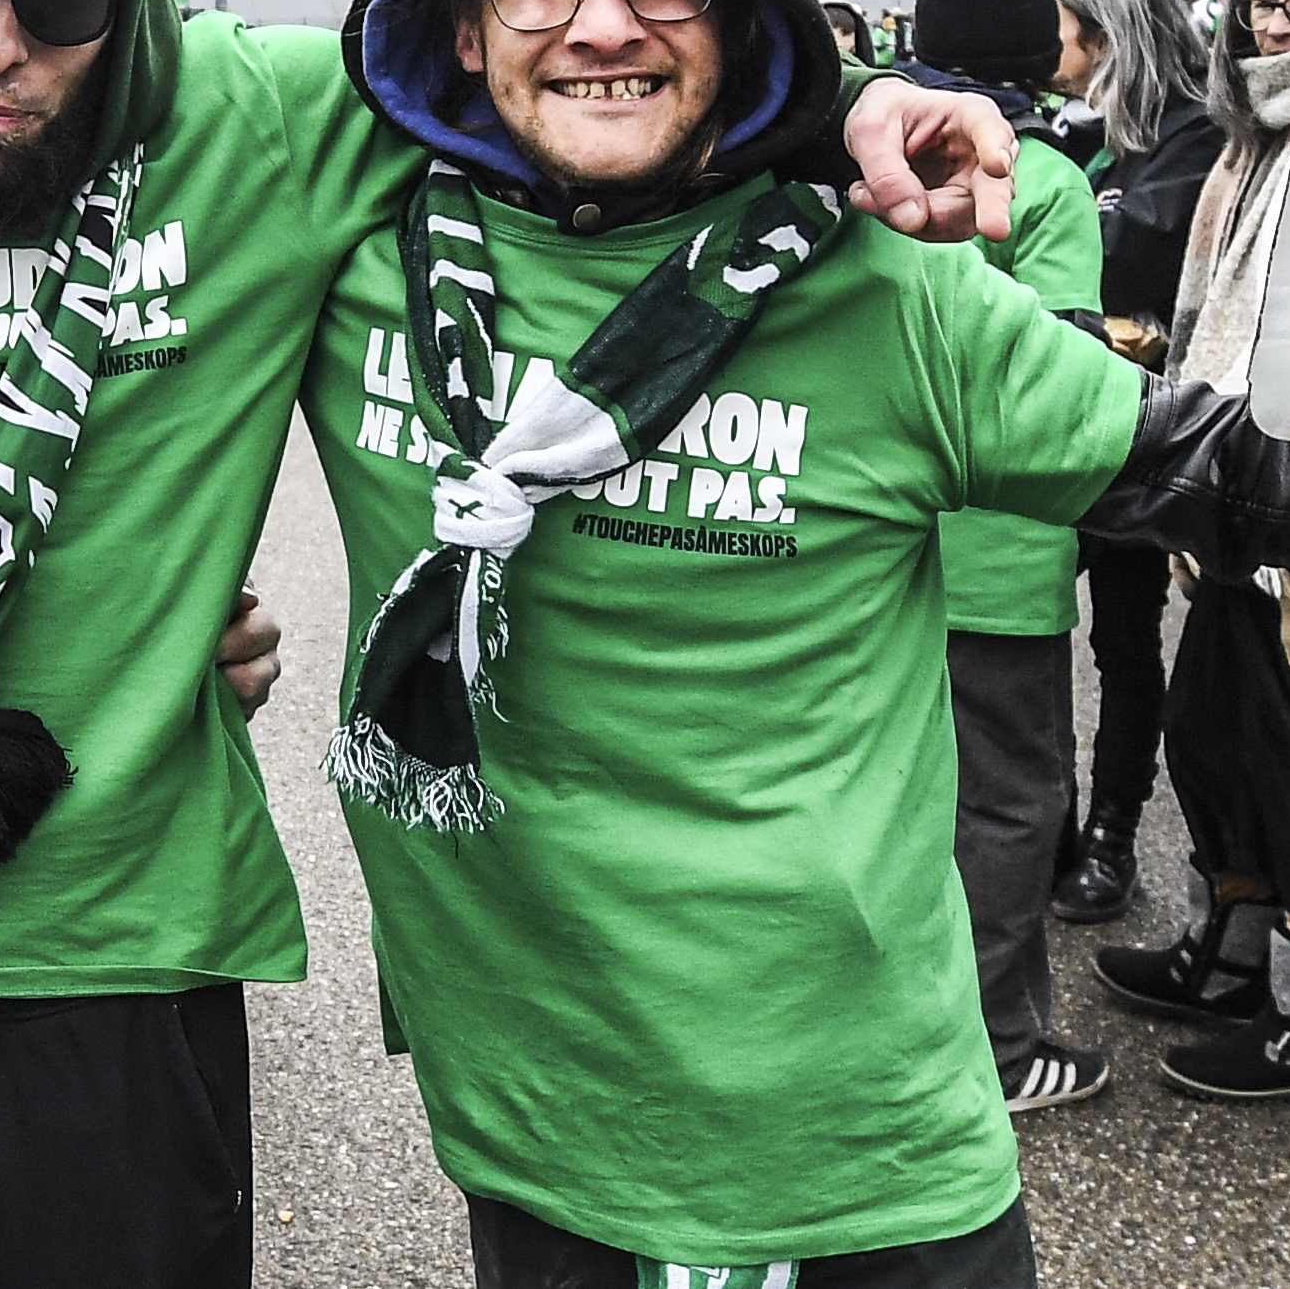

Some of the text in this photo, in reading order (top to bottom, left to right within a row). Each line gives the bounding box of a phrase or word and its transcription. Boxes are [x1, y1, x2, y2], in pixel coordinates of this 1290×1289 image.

[356, 400, 404, 458] NE
[687, 467, 796, 524] PAS.
[572, 513, 798, 558] #TOUCHEPASÀMESKOPS
